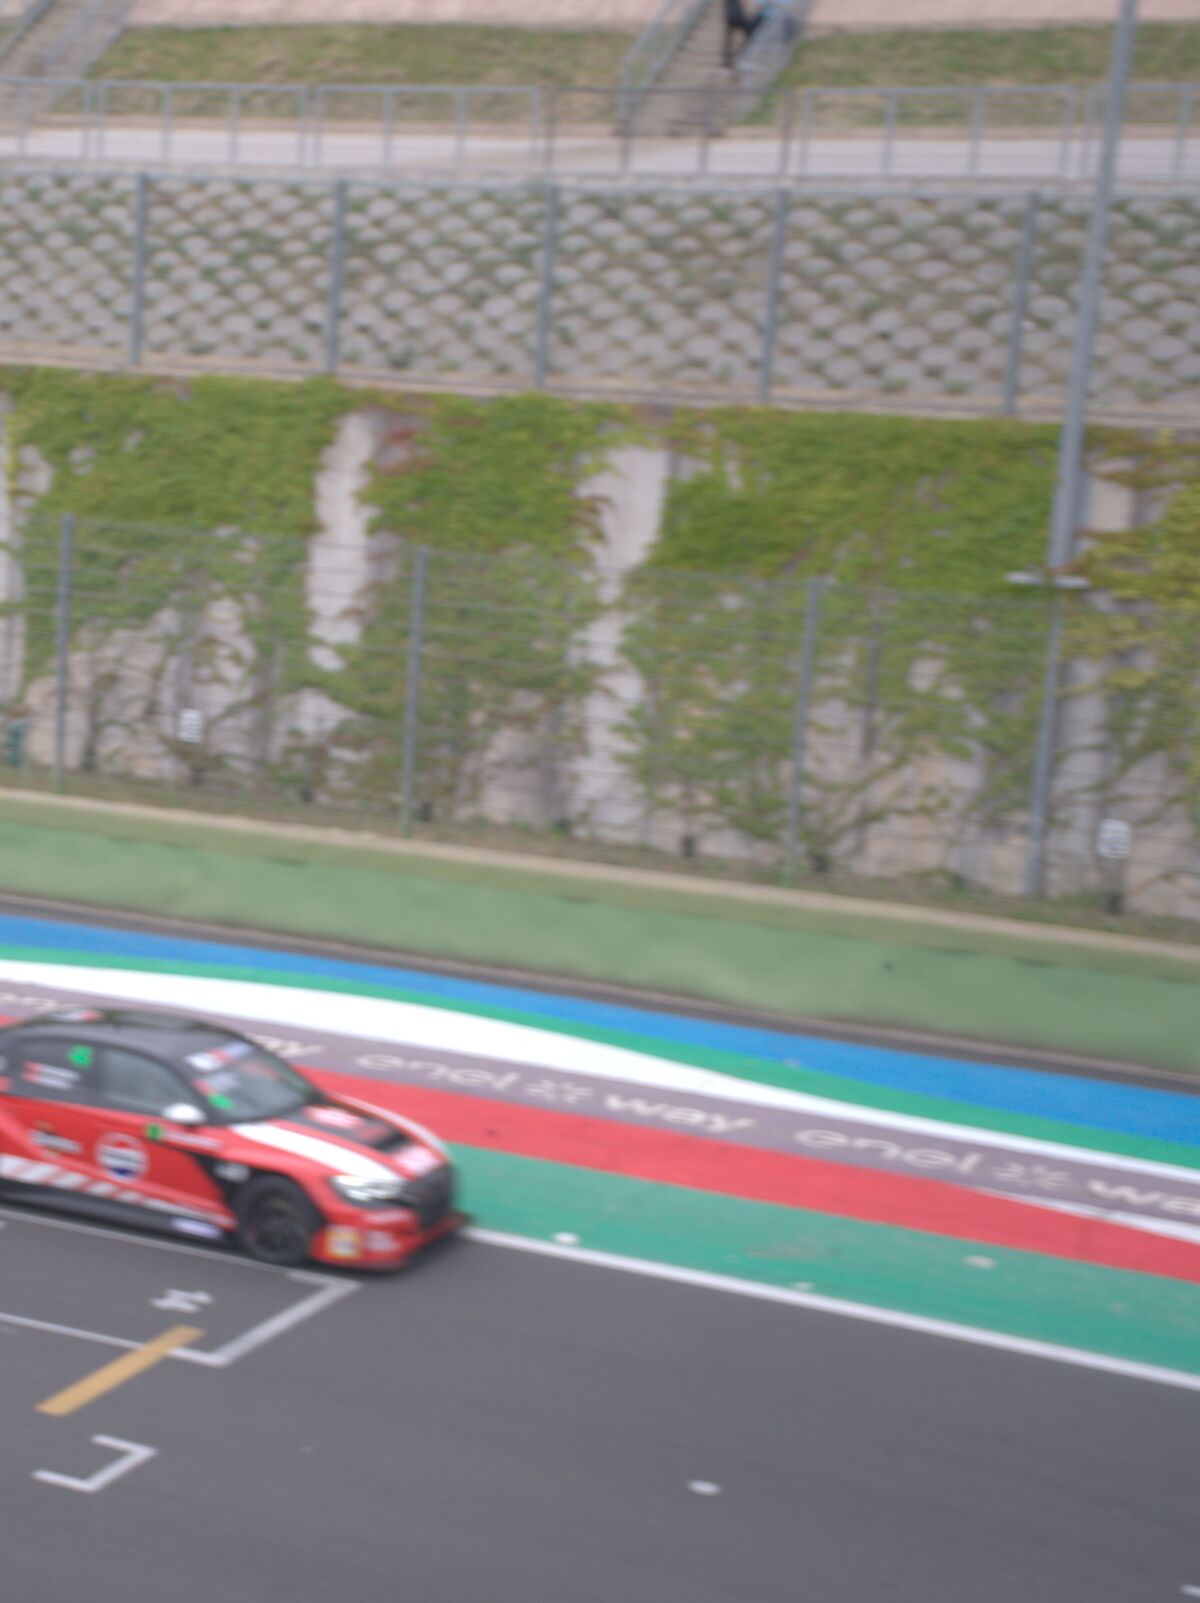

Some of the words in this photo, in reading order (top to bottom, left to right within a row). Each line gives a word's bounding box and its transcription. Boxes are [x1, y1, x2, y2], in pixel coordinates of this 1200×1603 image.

[355, 1052, 520, 1093] enel
[606, 1094, 757, 1133] way
[794, 1128, 983, 1174] enel
[1086, 1179, 1200, 1217] wa
